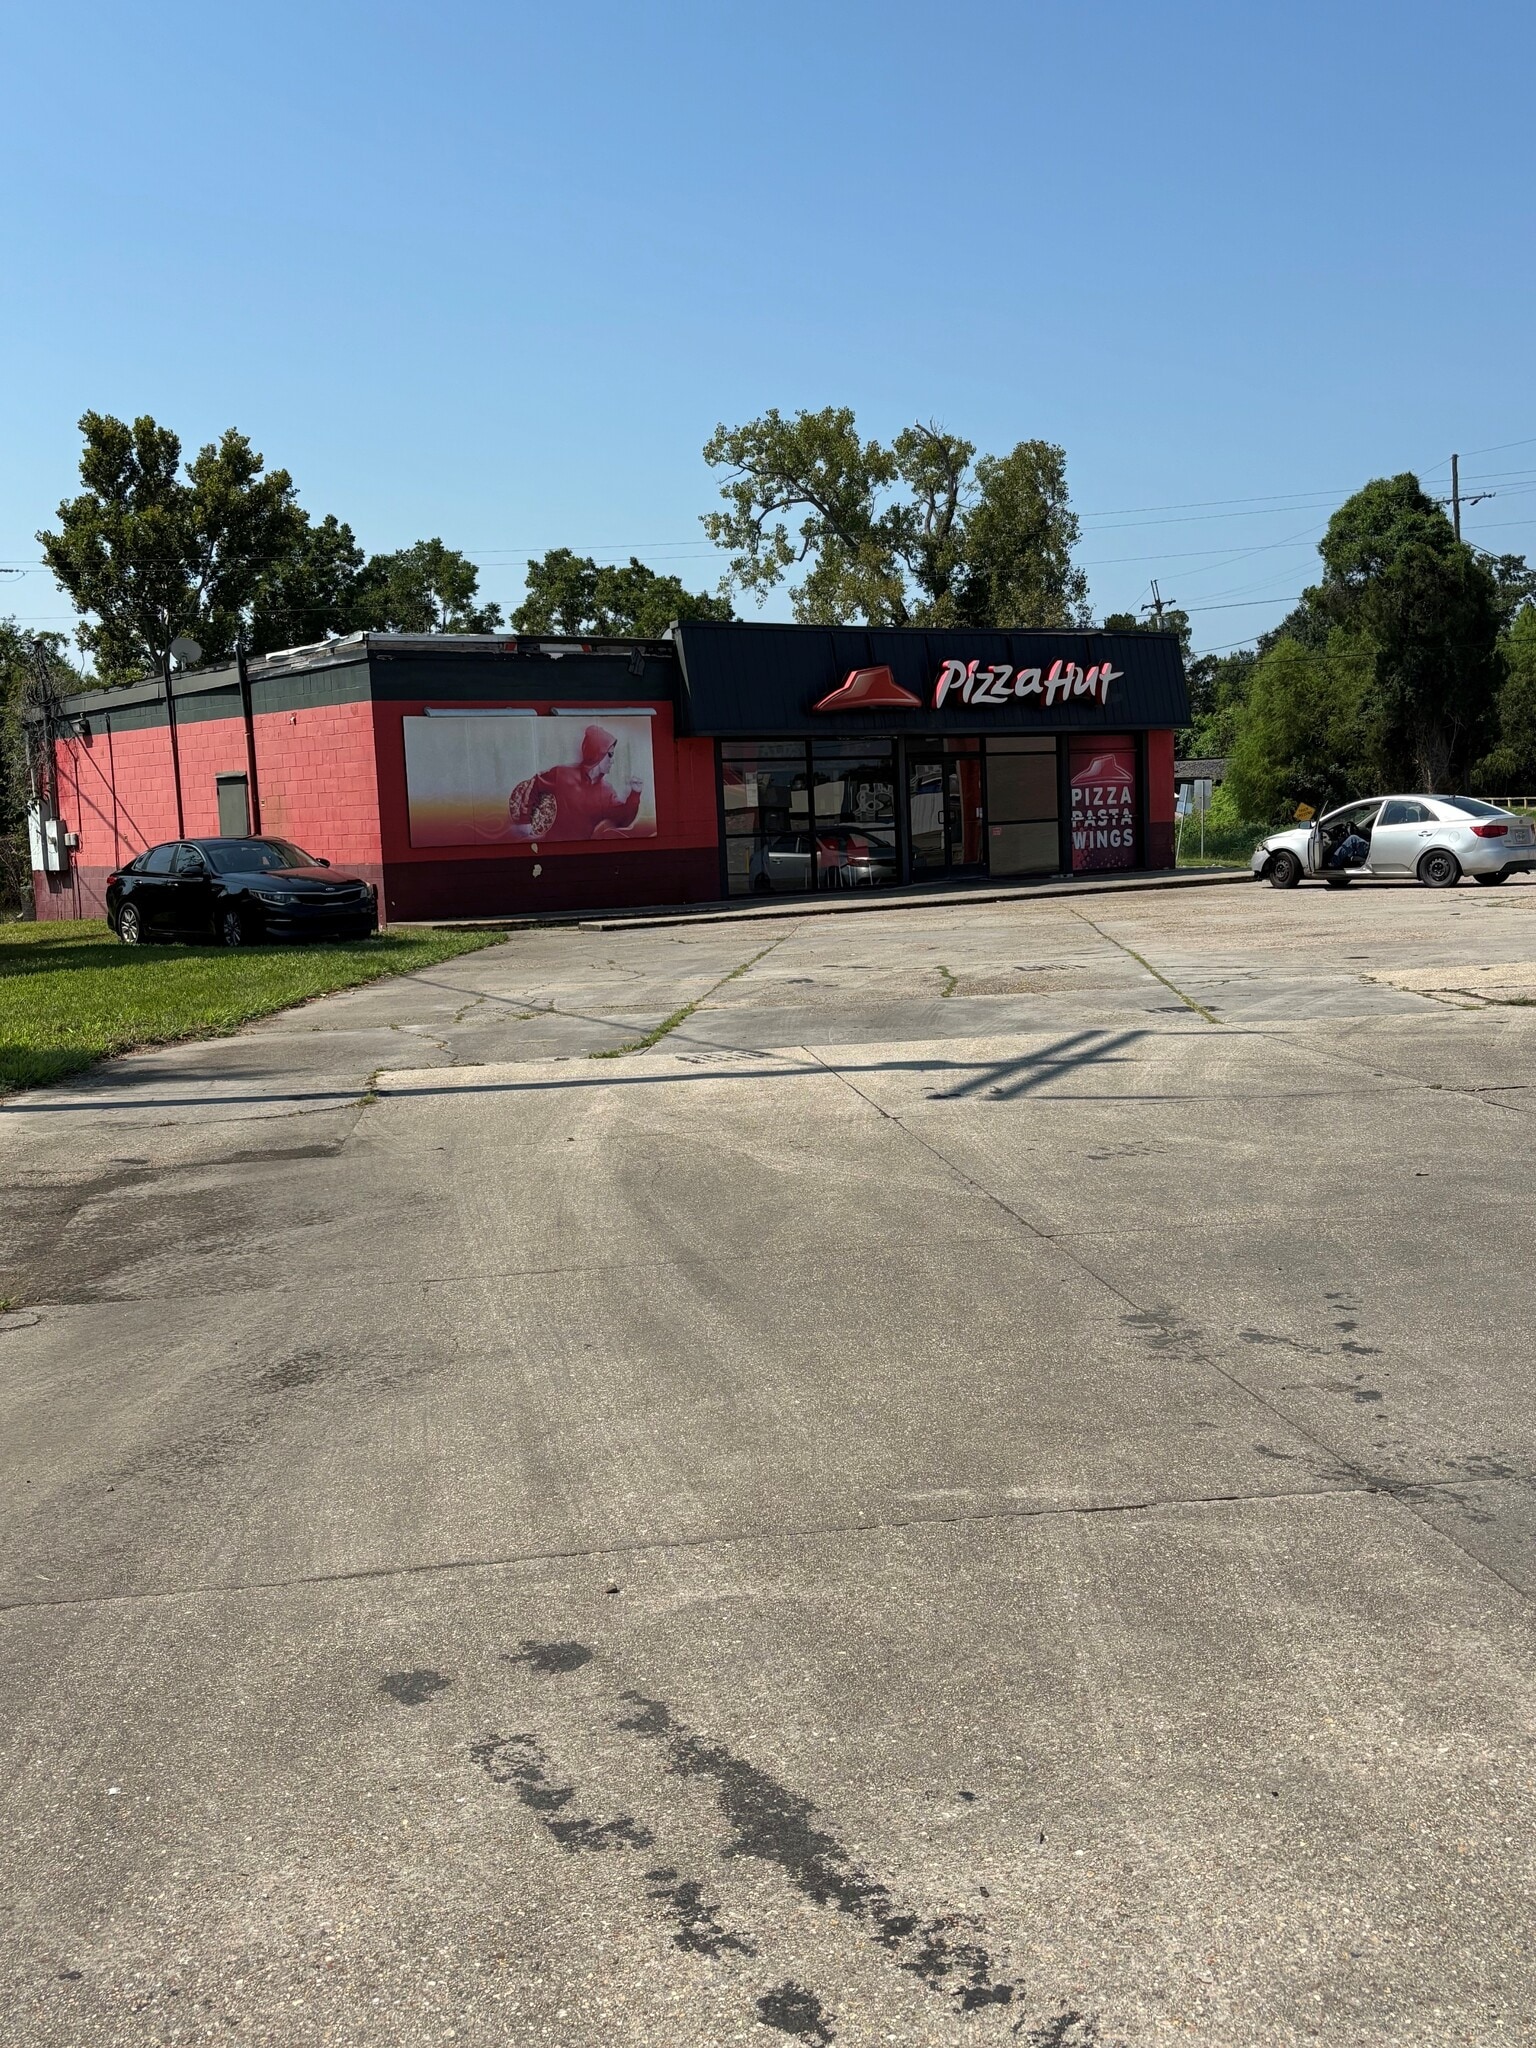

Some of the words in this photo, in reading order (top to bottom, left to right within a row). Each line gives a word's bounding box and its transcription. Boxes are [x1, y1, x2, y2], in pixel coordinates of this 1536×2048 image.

[935, 659, 1043, 709] Pizza
[1044, 659, 1125, 707] Hut
[1071, 786, 1132, 806] PIZZA
[1071, 807, 1133, 828] PASTA
[1072, 828, 1134, 849] WINGS
